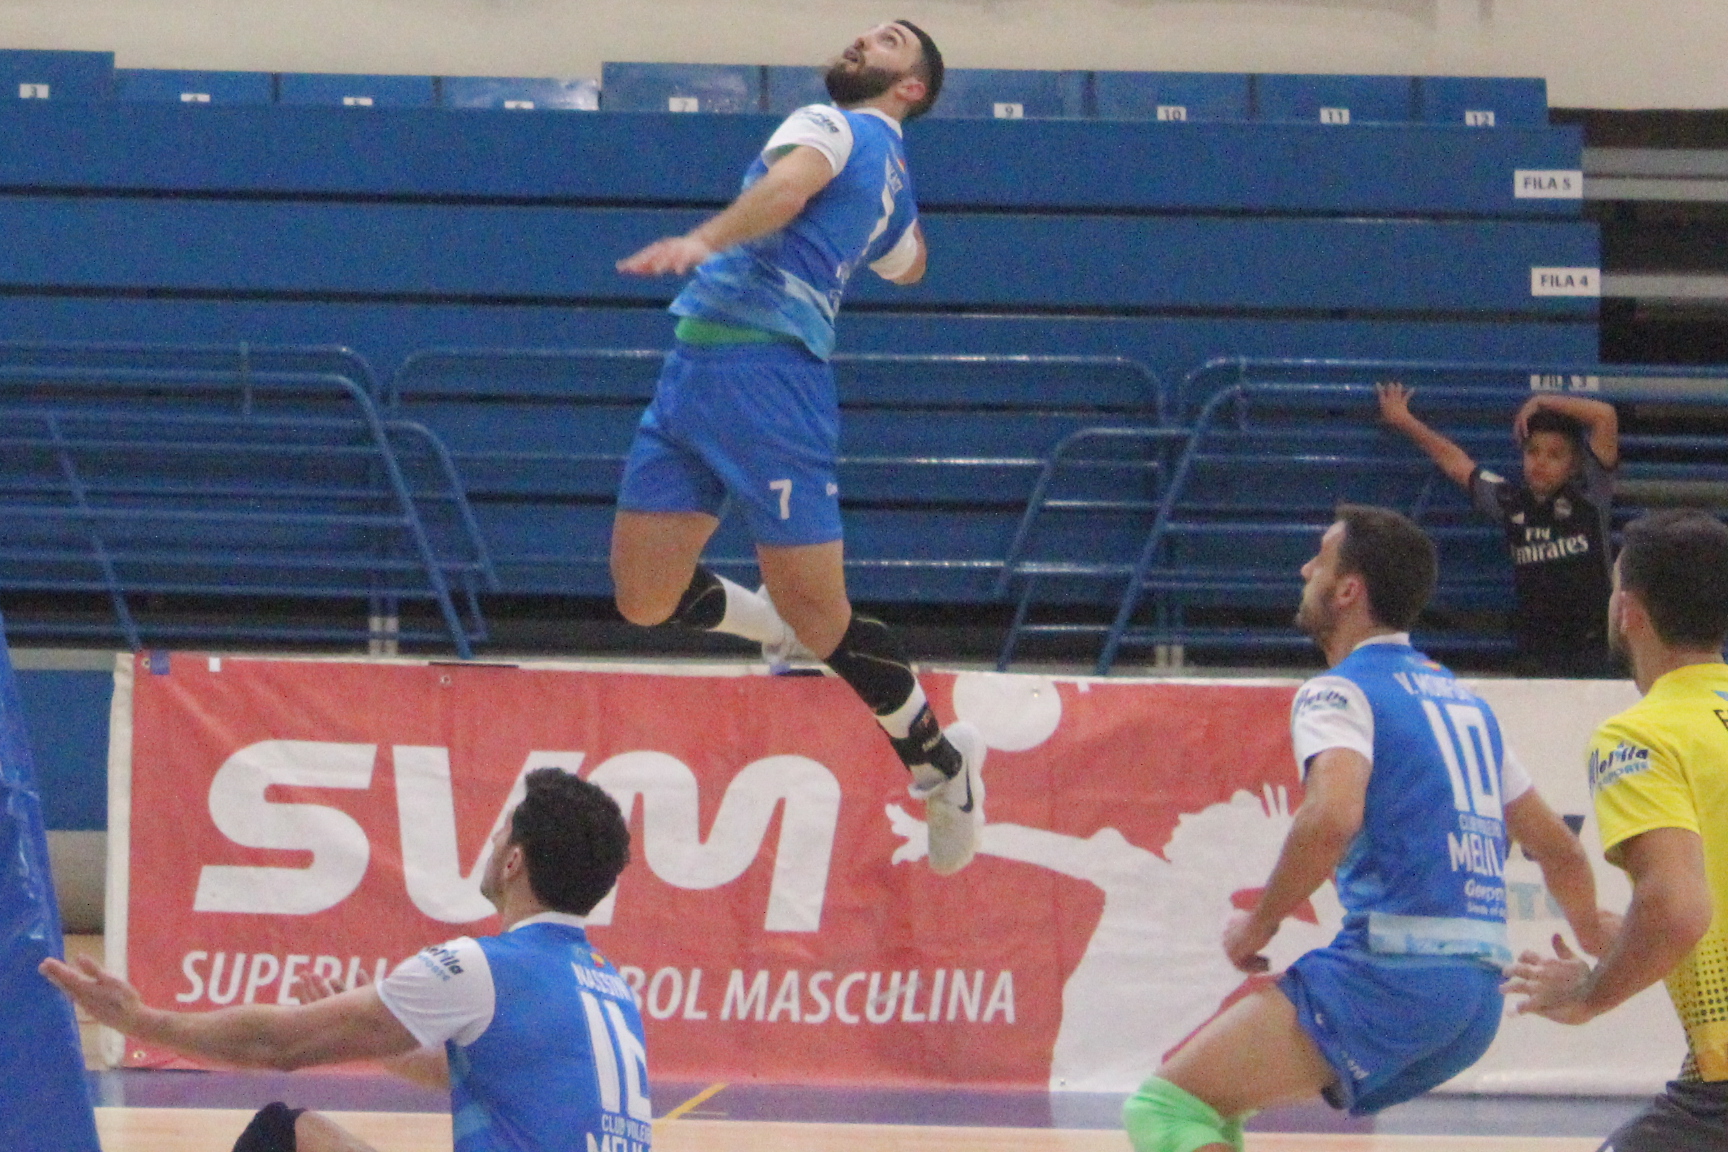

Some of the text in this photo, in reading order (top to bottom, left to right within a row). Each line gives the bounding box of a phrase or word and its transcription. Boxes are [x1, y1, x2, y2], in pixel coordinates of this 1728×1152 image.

[1164, 107, 1182, 121] 10
[1328, 109, 1344, 123] 11
[1523, 176, 1558, 191] FILA
[1540, 274, 1589, 288] FILA 4
[1539, 375, 1574, 388] FIL
[769, 478, 792, 520] 7
[1422, 699, 1504, 820] 10
[192, 739, 842, 933] SVM
[719, 968, 1016, 1024] MASCULINA
